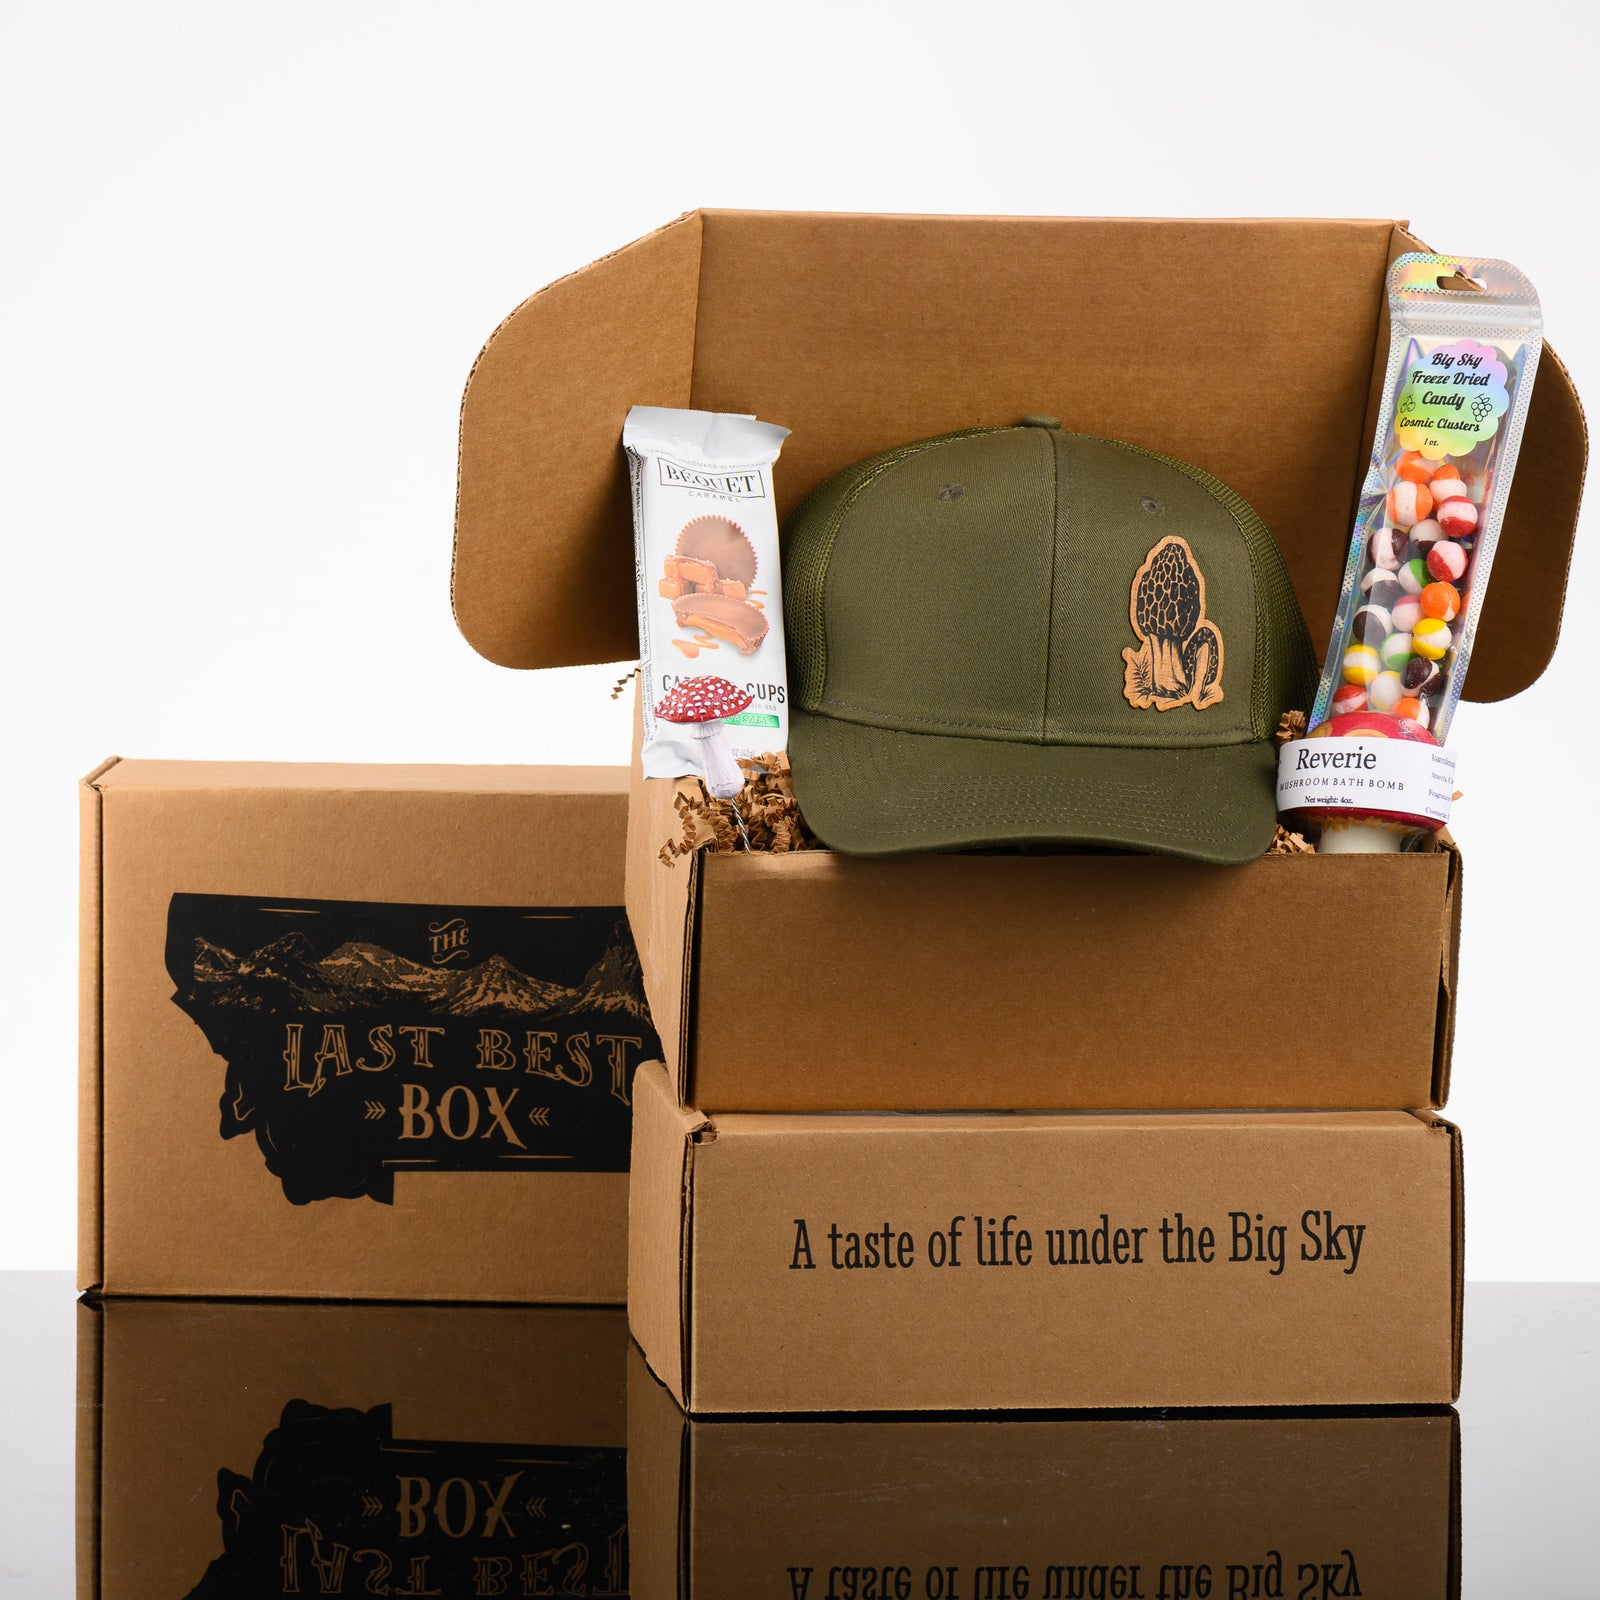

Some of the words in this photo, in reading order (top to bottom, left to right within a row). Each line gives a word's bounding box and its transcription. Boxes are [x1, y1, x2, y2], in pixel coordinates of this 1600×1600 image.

[1431, 352, 1455, 369] Big
[1456, 353, 1483, 369] Sky
[1412, 371, 1450, 385] Freeze
[1453, 372, 1491, 386] Dried
[1422, 391, 1466, 410] Candy
[1400, 417, 1434, 428] Cosmic
[1437, 418, 1480, 432] Clusters
[688, 490, 740, 503] CARAMEL
[747, 683, 785, 704] CUPS
[1295, 746, 1377, 770] Reverie
[1279, 777, 1329, 792] MUSHROOM
[1333, 778, 1364, 788] BATH
[1369, 779, 1404, 791] BOMB
[1304, 796, 1316, 804] Net
[1316, 796, 1338, 805] weight:
[428, 926, 470, 955] THE
[284, 1023, 445, 1097] LAST
[476, 1029, 642, 1107] BEST
[398, 1083, 528, 1150] BOX
[789, 1219, 816, 1270] A
[827, 1222, 915, 1269] taste
[928, 1216, 965, 1268] of
[974, 1215, 1032, 1267] life
[1046, 1214, 1148, 1266] under
[1159, 1213, 1215, 1264] the
[1228, 1211, 1288, 1276] Big
[1300, 1210, 1366, 1275] Sky
